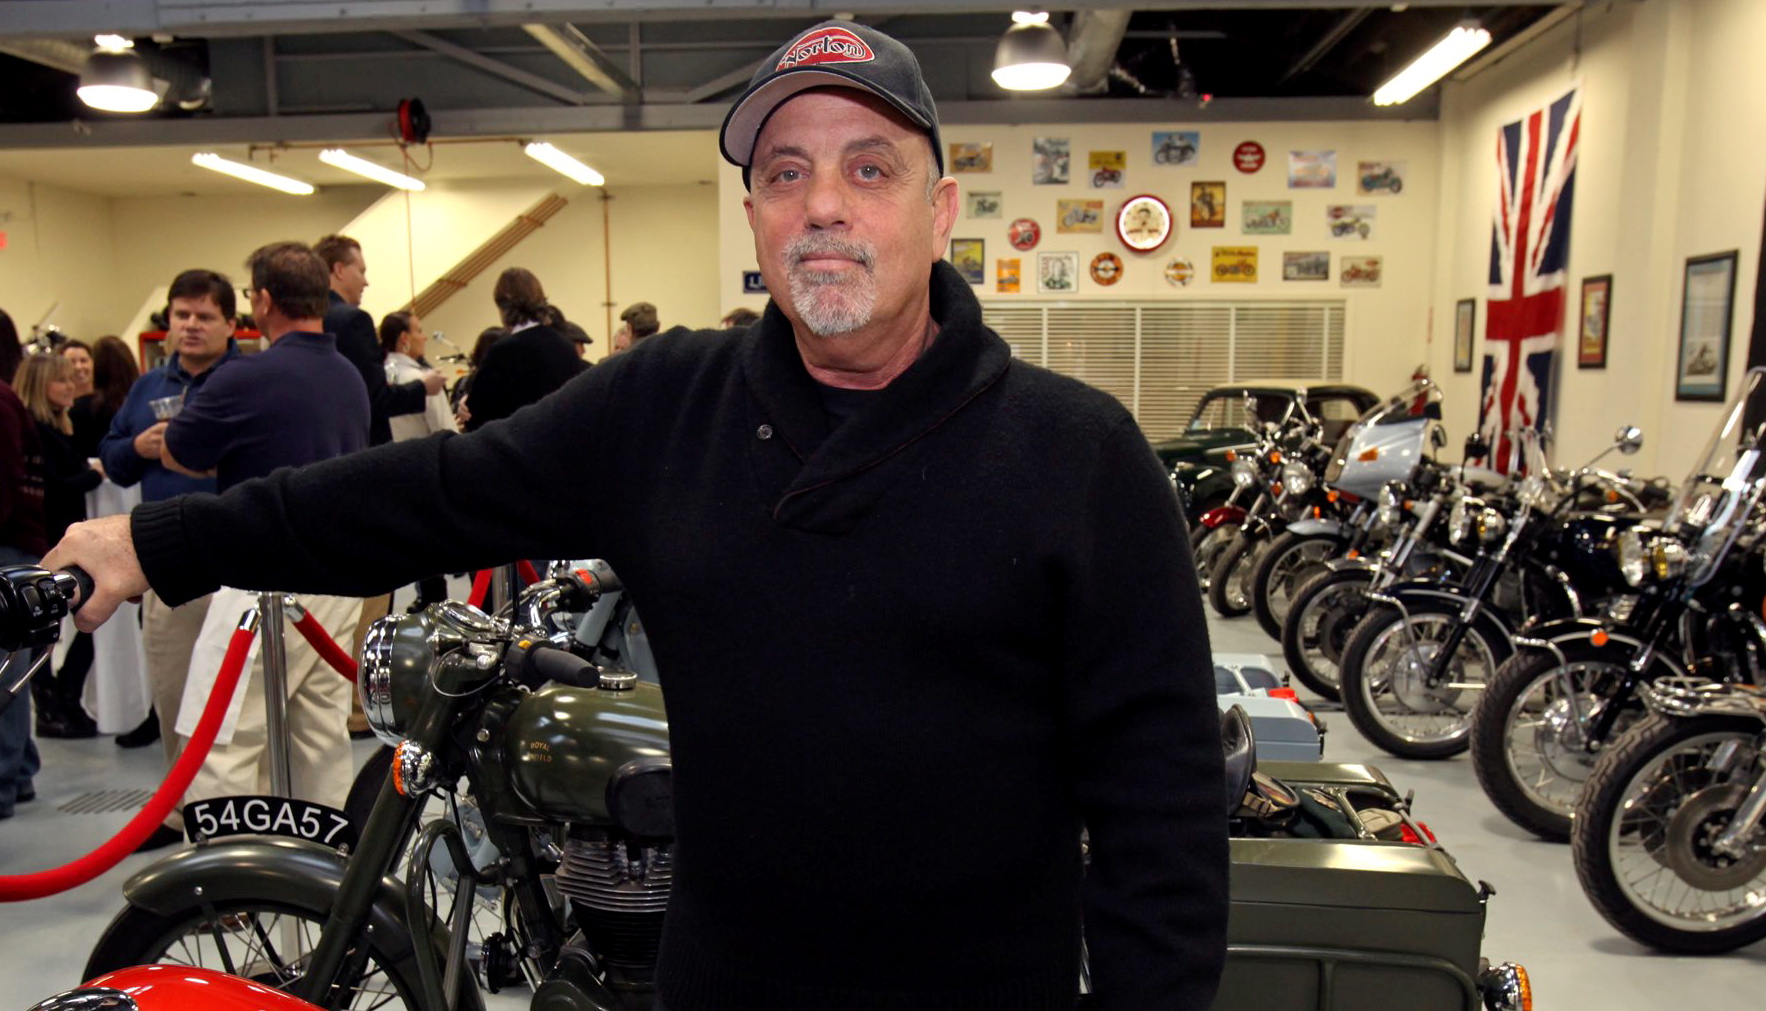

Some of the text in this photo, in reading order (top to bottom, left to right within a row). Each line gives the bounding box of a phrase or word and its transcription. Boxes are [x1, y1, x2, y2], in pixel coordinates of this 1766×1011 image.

[780, 35, 866, 68] Norton
[530, 741, 550, 751] ROYAL
[194, 799, 349, 844] 54GA57
